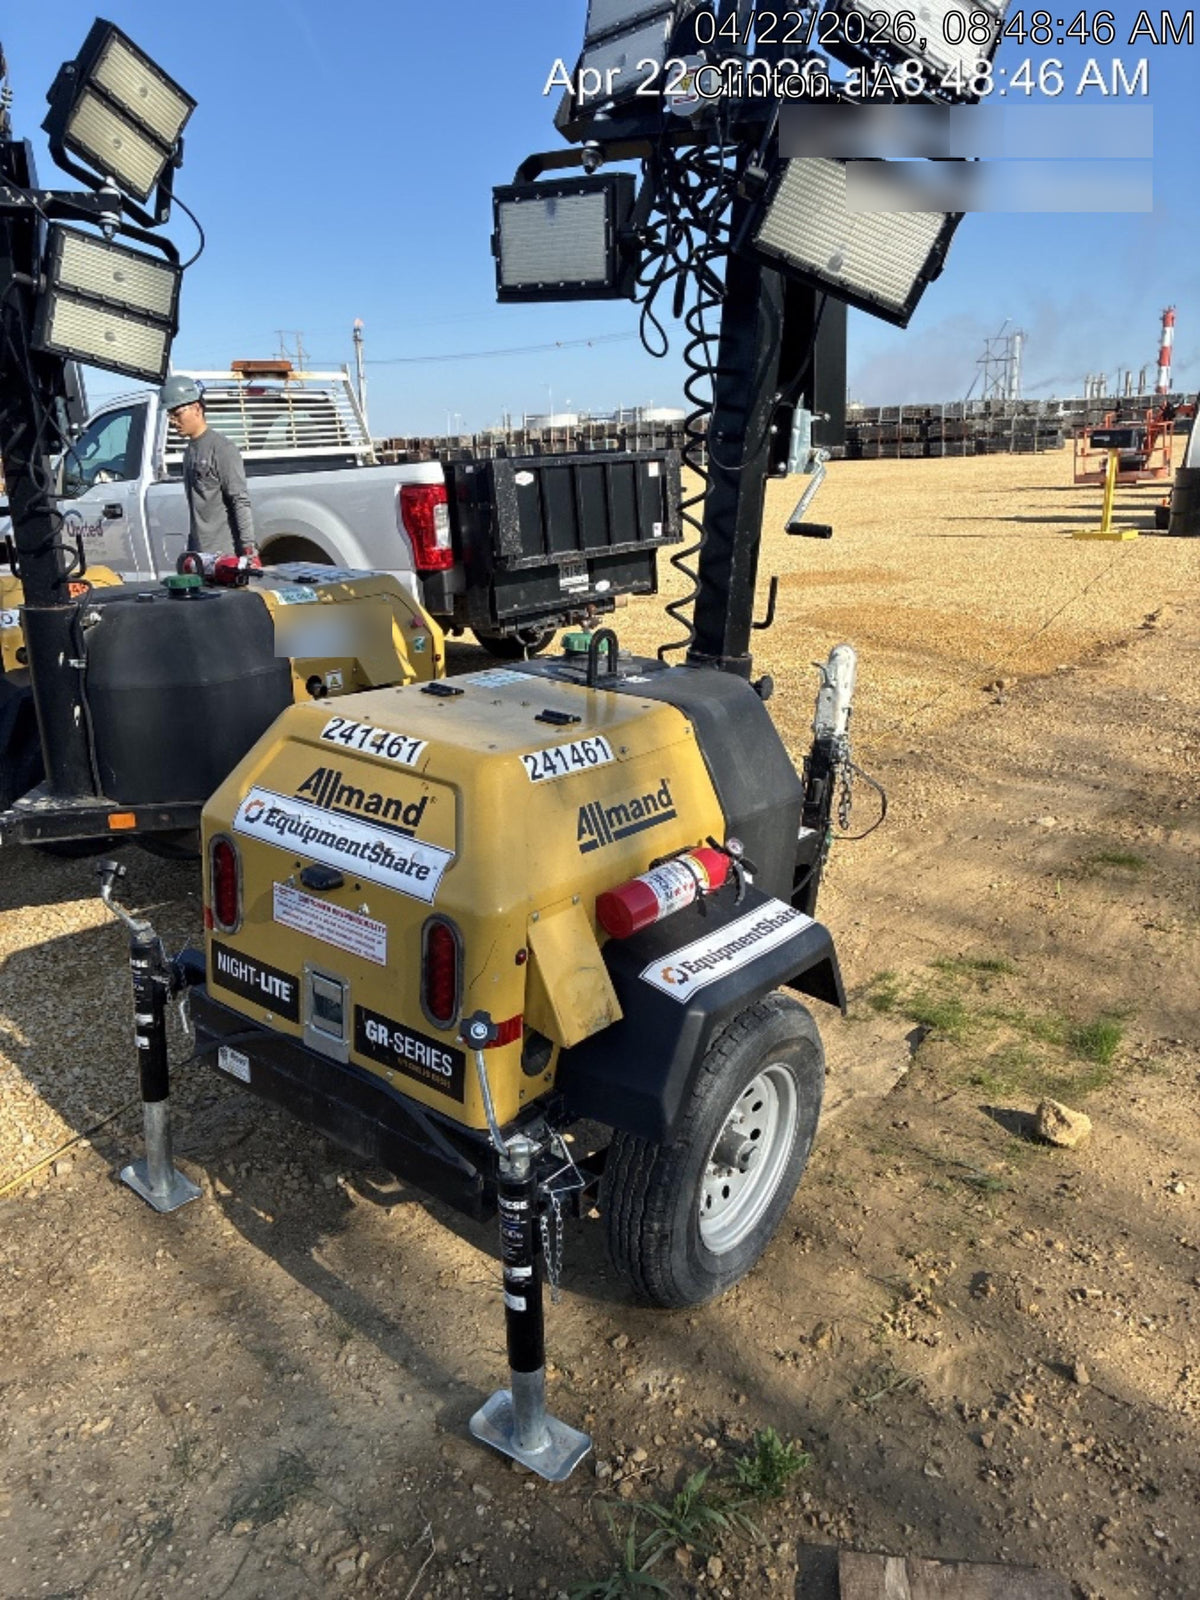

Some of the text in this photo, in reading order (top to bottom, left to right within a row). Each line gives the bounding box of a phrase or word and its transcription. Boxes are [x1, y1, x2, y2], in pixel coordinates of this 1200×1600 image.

[321, 717, 422, 765] 241461
[523, 736, 611, 782] 241461
[296, 767, 431, 829] Allmand
[577, 779, 674, 846] Allmand
[264, 806, 431, 881] EquipmentShare
[680, 907, 802, 975] EquipmentShare
[217, 951, 291, 1003] NIGHT-LITE
[365, 1019, 453, 1077] GR-SERIES
